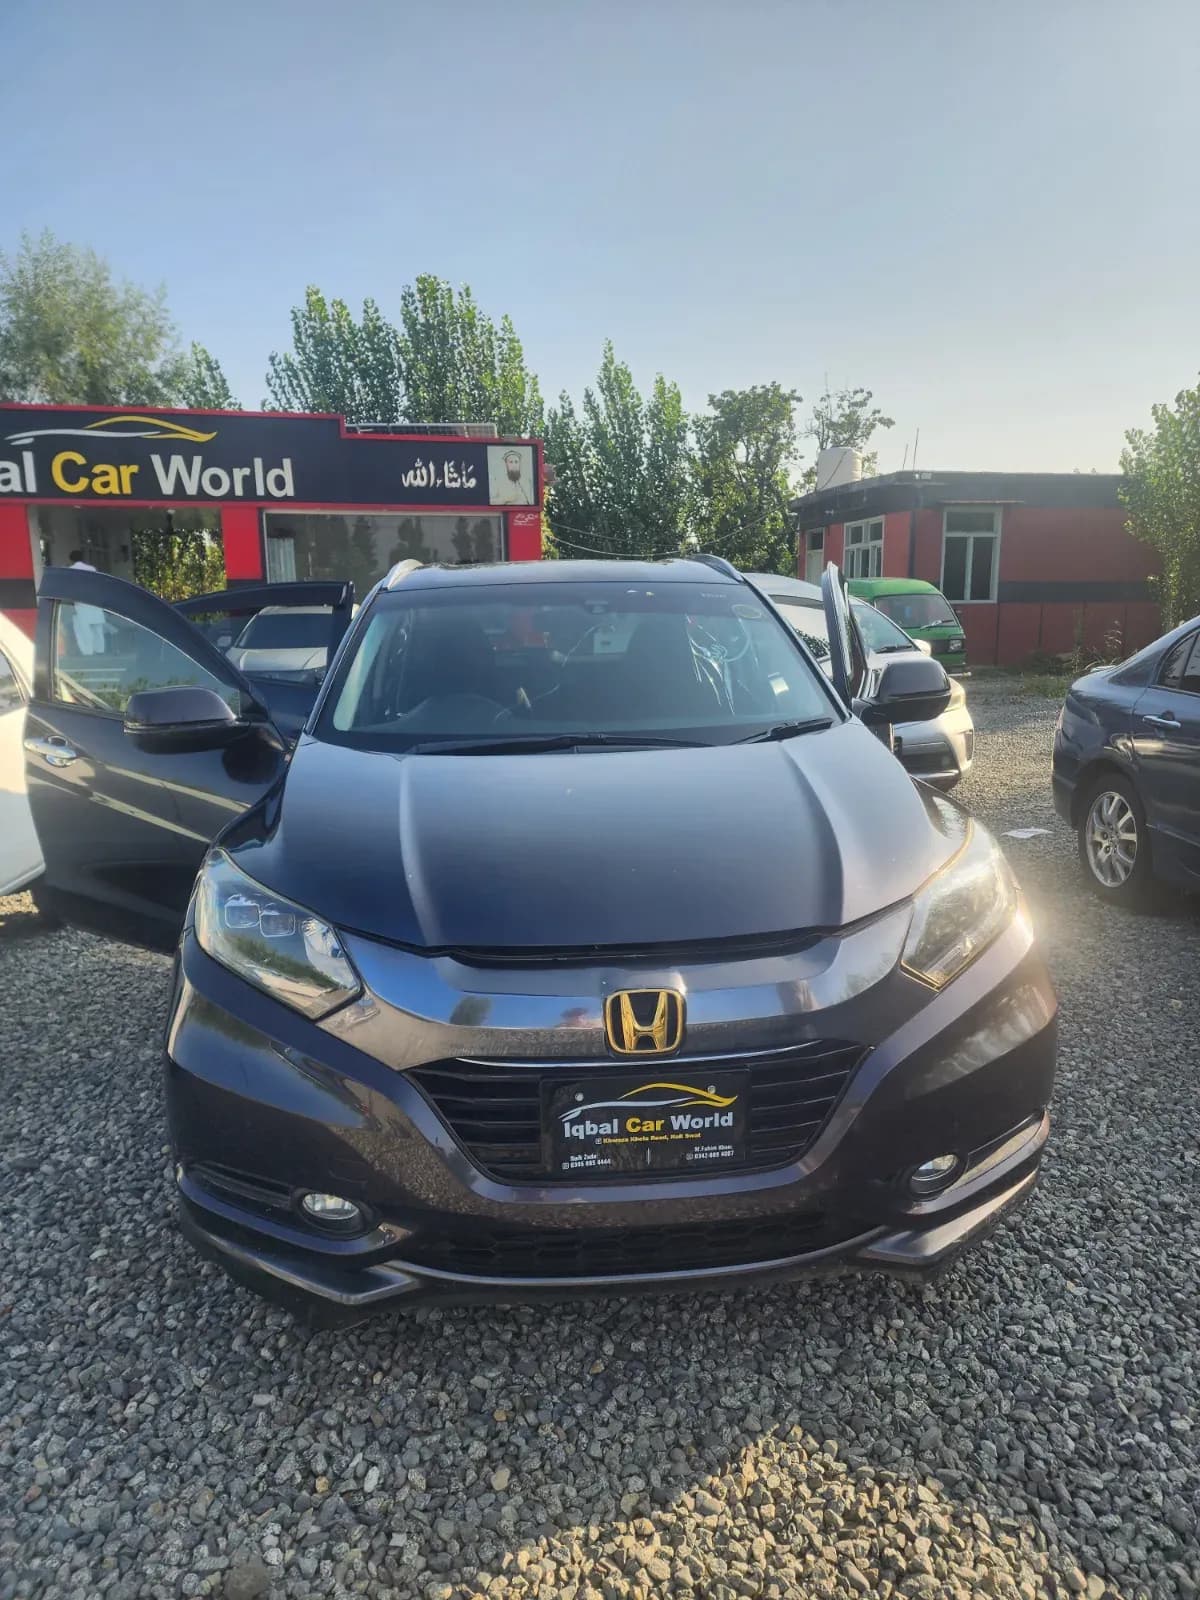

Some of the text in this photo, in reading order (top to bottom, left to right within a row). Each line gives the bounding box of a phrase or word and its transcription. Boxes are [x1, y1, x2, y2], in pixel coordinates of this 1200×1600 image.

[51, 451, 139, 495] Car
[150, 454, 295, 497] World
[564, 1112, 733, 1139] Iqbal Car World
